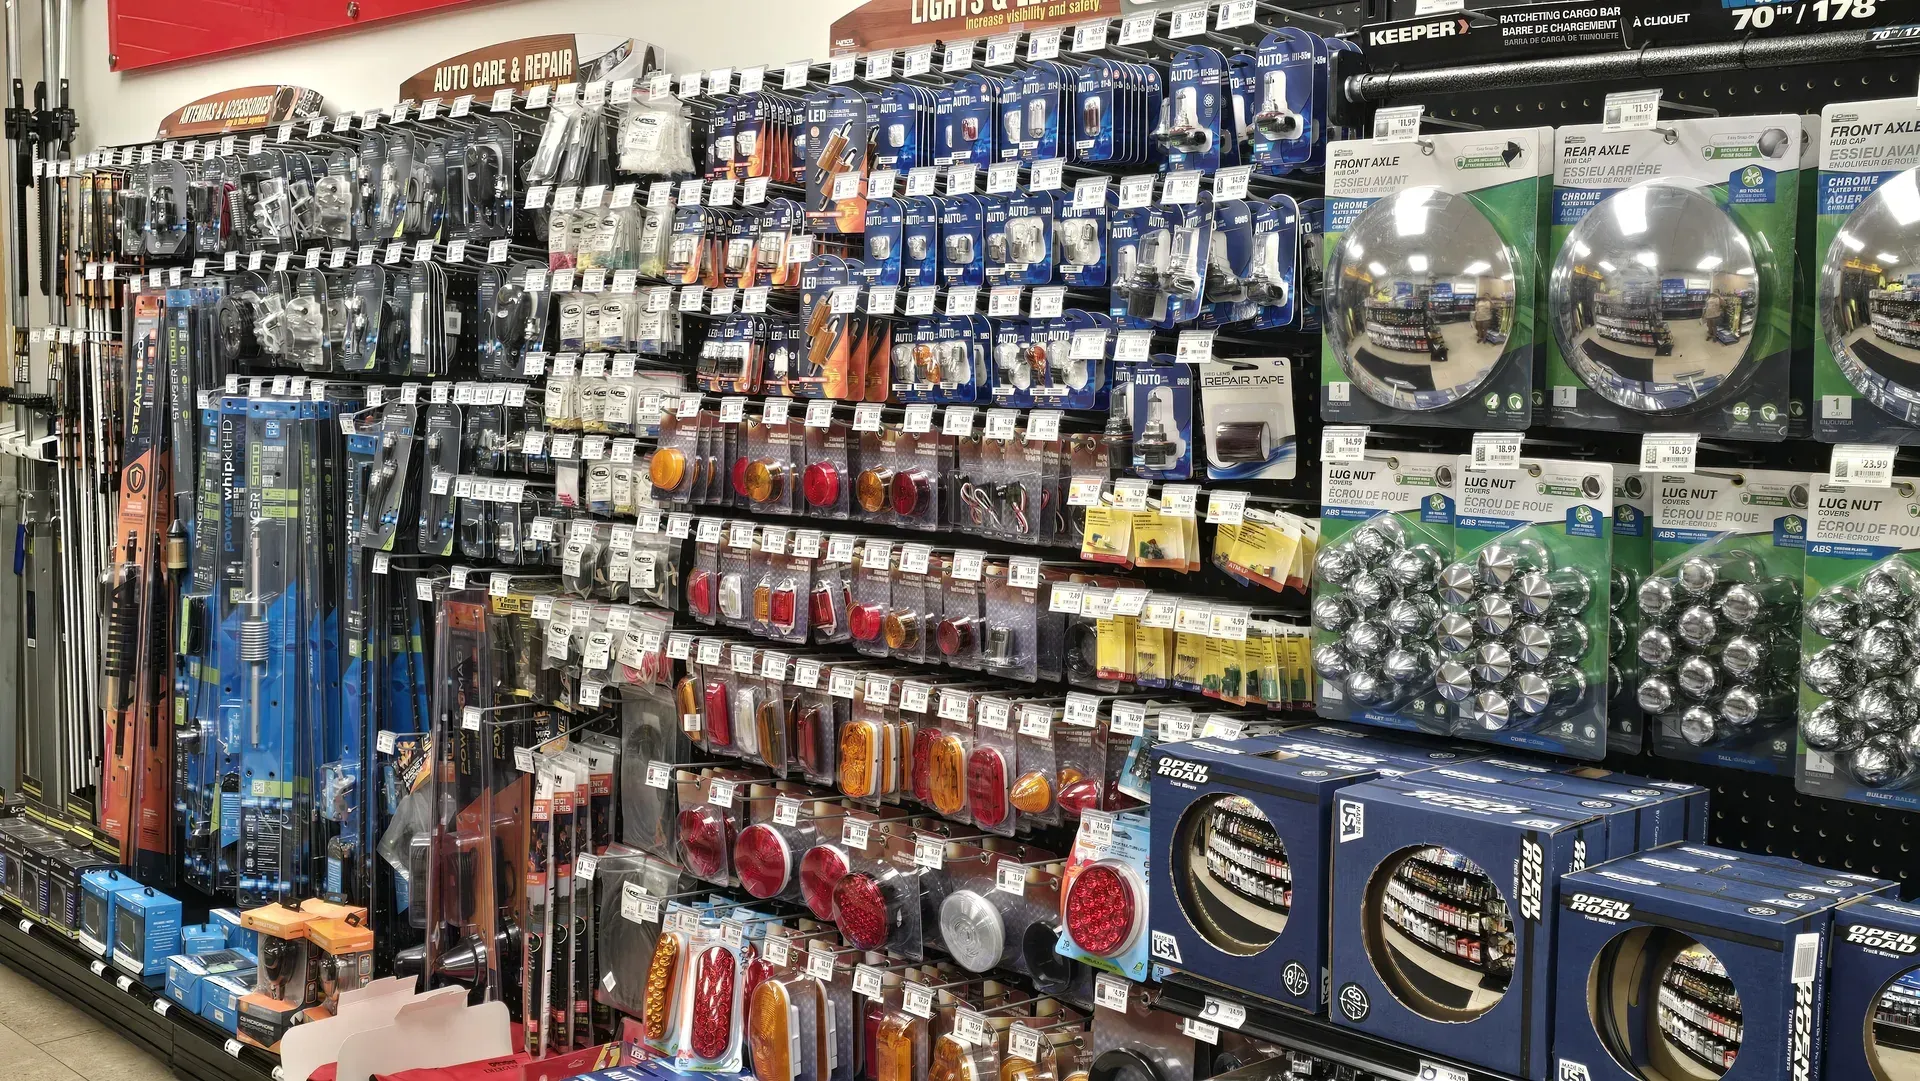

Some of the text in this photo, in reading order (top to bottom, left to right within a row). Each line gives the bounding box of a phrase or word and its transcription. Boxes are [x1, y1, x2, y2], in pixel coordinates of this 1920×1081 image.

[1007, 8, 1045, 23] visibility
[1048, 5, 1066, 17] and
[1500, 7, 1621, 24] RATCHETING CARGO BAR
[1633, 14, 1690, 27] À CLIQUET
[1370, 21, 1455, 46] KEEPER
[1503, 20, 1617, 37] BARRE DE CHARGEMENT
[1504, 32, 1619, 46] BARRA DE CARGA DE TRINQUETE
[1257, 54, 1282, 67] AUTO
[434, 64, 468, 92] AUTO
[472, 59, 506, 87] CARE
[511, 57, 520, 83] &
[524, 48, 572, 81] REPAIR
[1171, 69, 1192, 82] AUTO
[1023, 83, 1040, 95] AUTO
[1078, 82, 1094, 93] AUTO
[953, 95, 970, 106] AUTO
[179, 102, 215, 124] ANTENNAS
[215, 103, 223, 121] &
[223, 95, 273, 119] ACCESSORIES
[880, 103, 896, 113] AUTO
[1632, 103, 1654, 113] $11.99
[808, 109, 826, 123] LED
[1398, 118, 1417, 128] $11.99
[1831, 121, 1920, 138] FRONT AXLE
[1564, 145, 1630, 157] REAR AXLE
[1830, 147, 1884, 160] ESSIEU
[1334, 156, 1399, 169] FRONT AXLE
[1829, 160, 1879, 168] ENJOLIVEUR
[1563, 162, 1662, 178] ESSIEU ARRIÈRE
[1333, 175, 1408, 188] ESSIEU AVANT
[1828, 176, 1879, 186] CHROME
[1562, 192, 1601, 200] CHROME
[1827, 195, 1862, 204] ACIER
[1009, 206, 1028, 217] AUTO
[1332, 201, 1368, 209] CHROME
[944, 213, 961, 224] AUTO
[1561, 208, 1588, 216] ACIER
[1112, 226, 1132, 239] AUTO
[1255, 219, 1274, 234] AUTO
[803, 277, 816, 289] LED
[939, 328, 954, 339] AUTO
[1048, 330, 1069, 341] AUTO
[1135, 373, 1161, 385] AUTO
[1205, 376, 1284, 385] REPAIR TAPE
[1562, 388, 1566, 399] 1
[132, 370, 143, 435] STEALTH
[1486, 393, 1499, 409] 4
[1833, 397, 1839, 409] 1
[1344, 438, 1362, 446] $14.99
[1496, 445, 1517, 453] $18.99
[1669, 446, 1692, 456] $18.99
[1862, 460, 1888, 470] $23.99
[1329, 470, 1376, 481] LUG NUT
[1464, 477, 1516, 489] LUG NUT
[1329, 486, 1409, 501] ÉCROU DE ROUE
[1662, 488, 1718, 499] LUG NUT
[1464, 494, 1554, 512] ÉCROU DE ROUE
[1818, 498, 1882, 511] LUG NUT
[195, 495, 203, 548] STINGER
[1662, 506, 1759, 524] ÉCROU DE ROUE
[1817, 517, 1920, 537] ÉCROU DE ROU
[1658, 531, 1676, 539] ABS
[1812, 545, 1832, 554] ABS
[1561, 722, 1573, 733] 33
[1773, 741, 1787, 751] 33
[1158, 757, 1208, 774] OPEN
[1157, 766, 1208, 784] ROAD
[1342, 802, 1356, 835] USA
[1521, 838, 1533, 919] ROAD
[1531, 842, 1543, 921] OPEN
[1571, 893, 1631, 912] OPEN
[1570, 901, 1631, 921] ROAD
[1154, 934, 1168, 942] MADE
[1849, 925, 1917, 945] OPEN
[1154, 940, 1177, 960] USA
[1847, 934, 1917, 954] ROAD
[1863, 947, 1899, 959] Truck Mirrors
